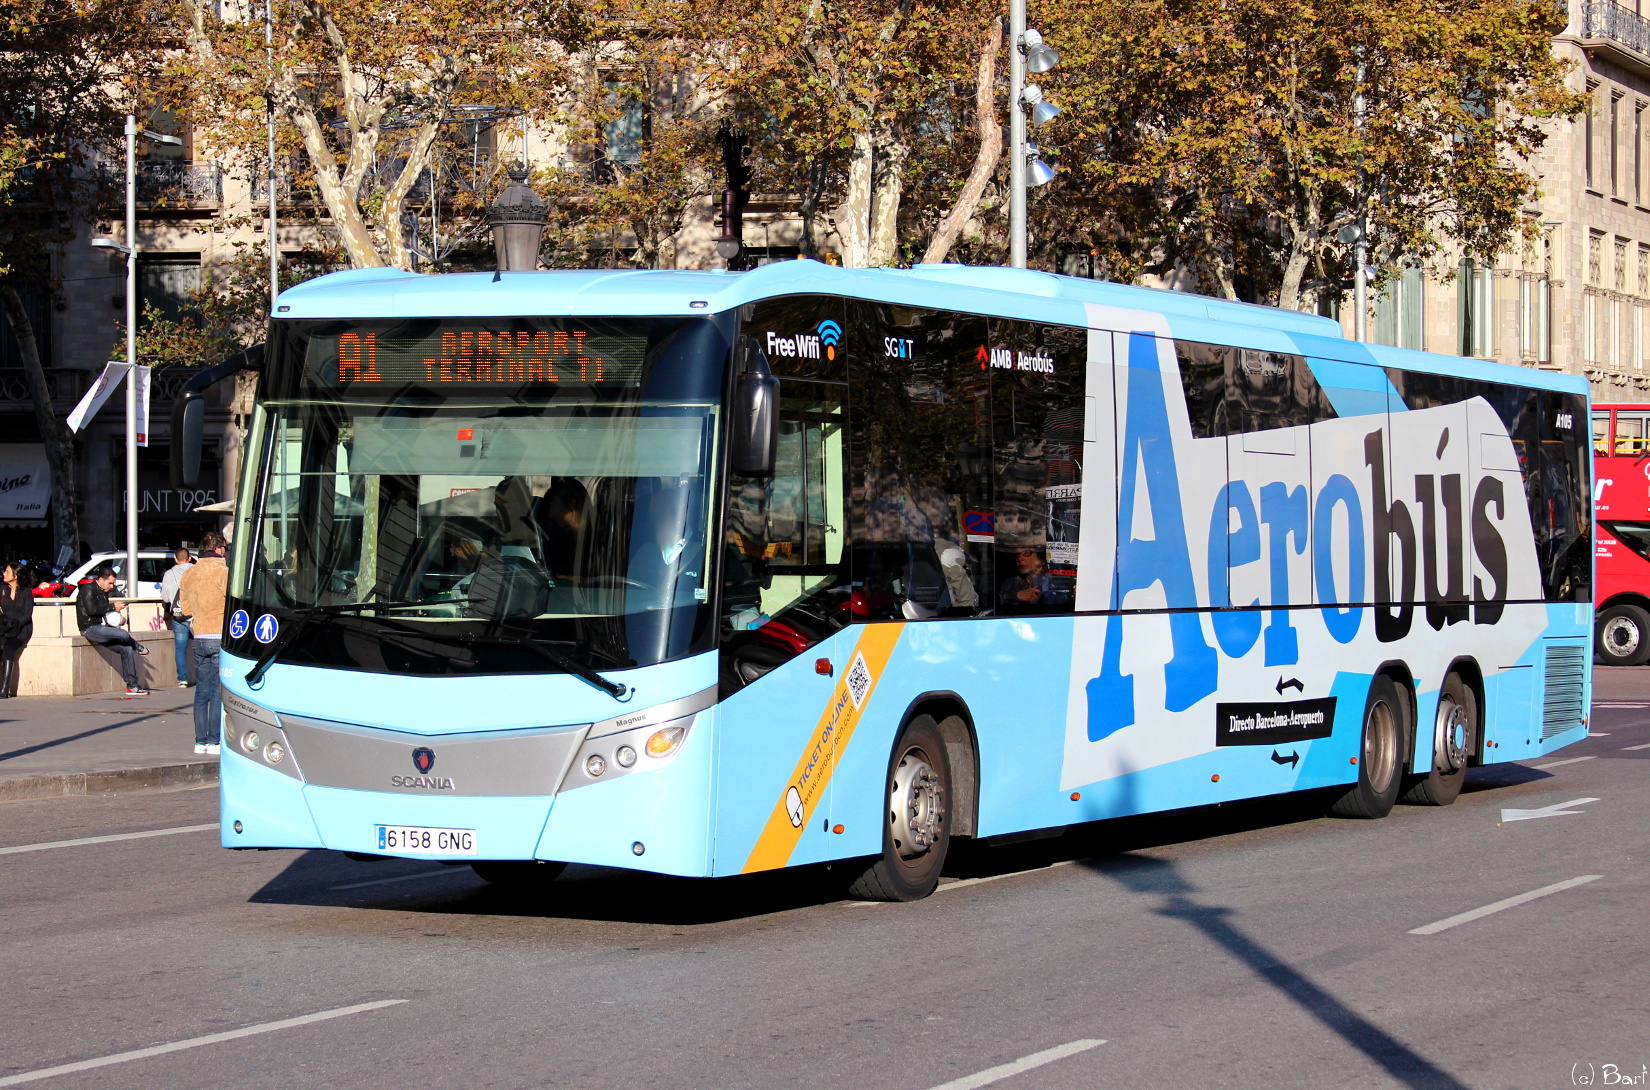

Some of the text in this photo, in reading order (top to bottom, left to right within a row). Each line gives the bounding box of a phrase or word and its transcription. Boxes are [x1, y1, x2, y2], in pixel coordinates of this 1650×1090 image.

[442, 331, 587, 356] AEROPORT
[766, 331, 821, 360] Free Wifi
[339, 332, 381, 382] A1
[990, 348, 1054, 374] AMB Aerobús
[423, 357, 604, 382] TERMINAL T1
[1555, 413, 1573, 430] A105
[0, 474, 31, 491] ino
[177, 489, 216, 513] 1995
[1086, 330, 1509, 743] Aerobús
[616, 714, 647, 727] Magnus
[1229, 709, 1324, 732] Directo Barcelona-Aeropuerto
[797, 689, 850, 789] TICKET ON-LINE
[391, 775, 456, 790] SCANIA
[387, 830, 472, 850] 6158 GNG
